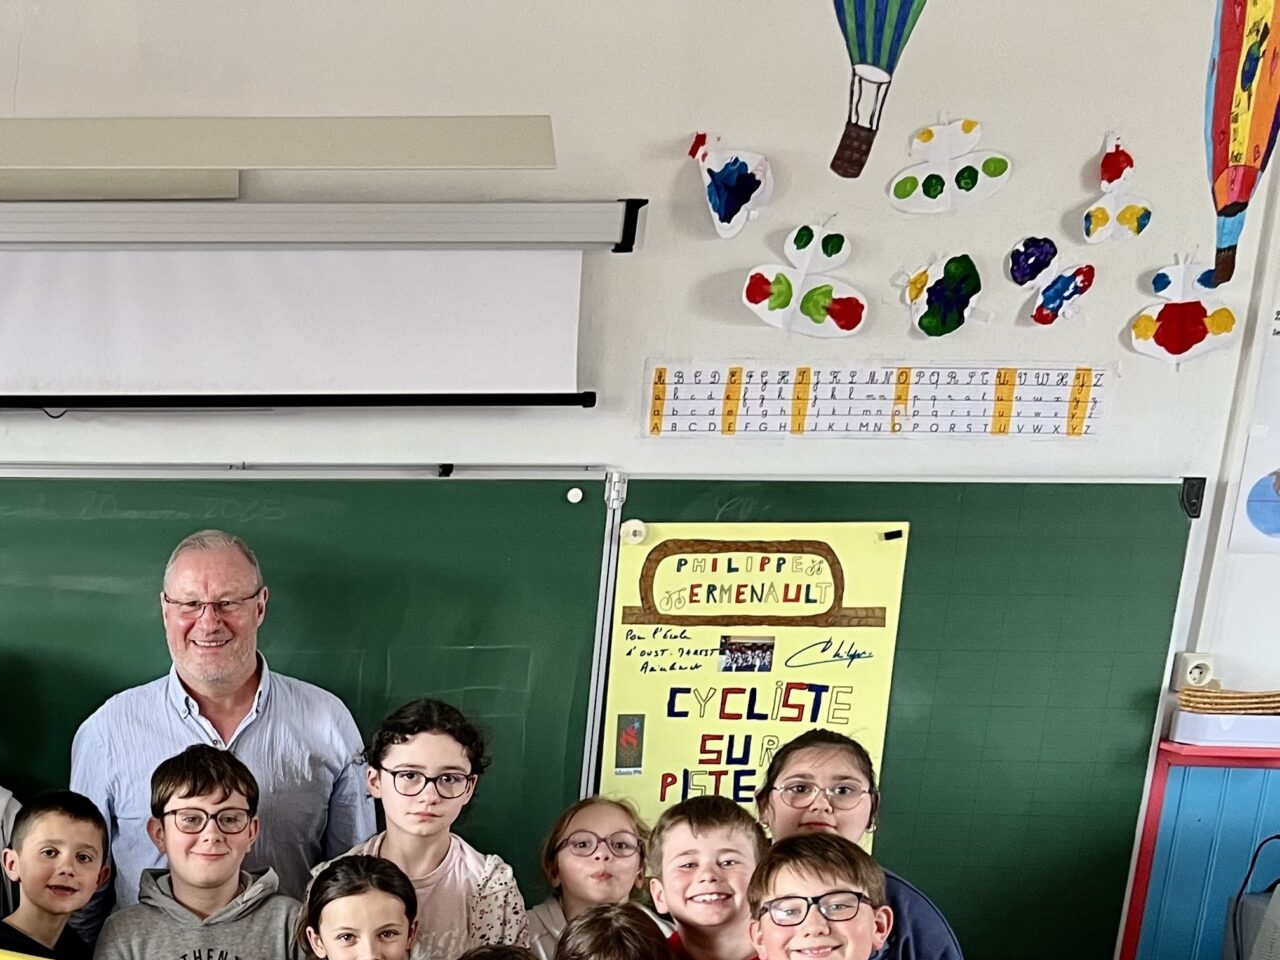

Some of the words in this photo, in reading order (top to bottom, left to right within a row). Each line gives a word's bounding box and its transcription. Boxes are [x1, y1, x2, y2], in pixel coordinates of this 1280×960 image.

[676, 556, 804, 573] PHILIPPE
[689, 581, 832, 604] ERMENAULT
[698, 734, 781, 767] SUR
[660, 769, 757, 804] PISTE
